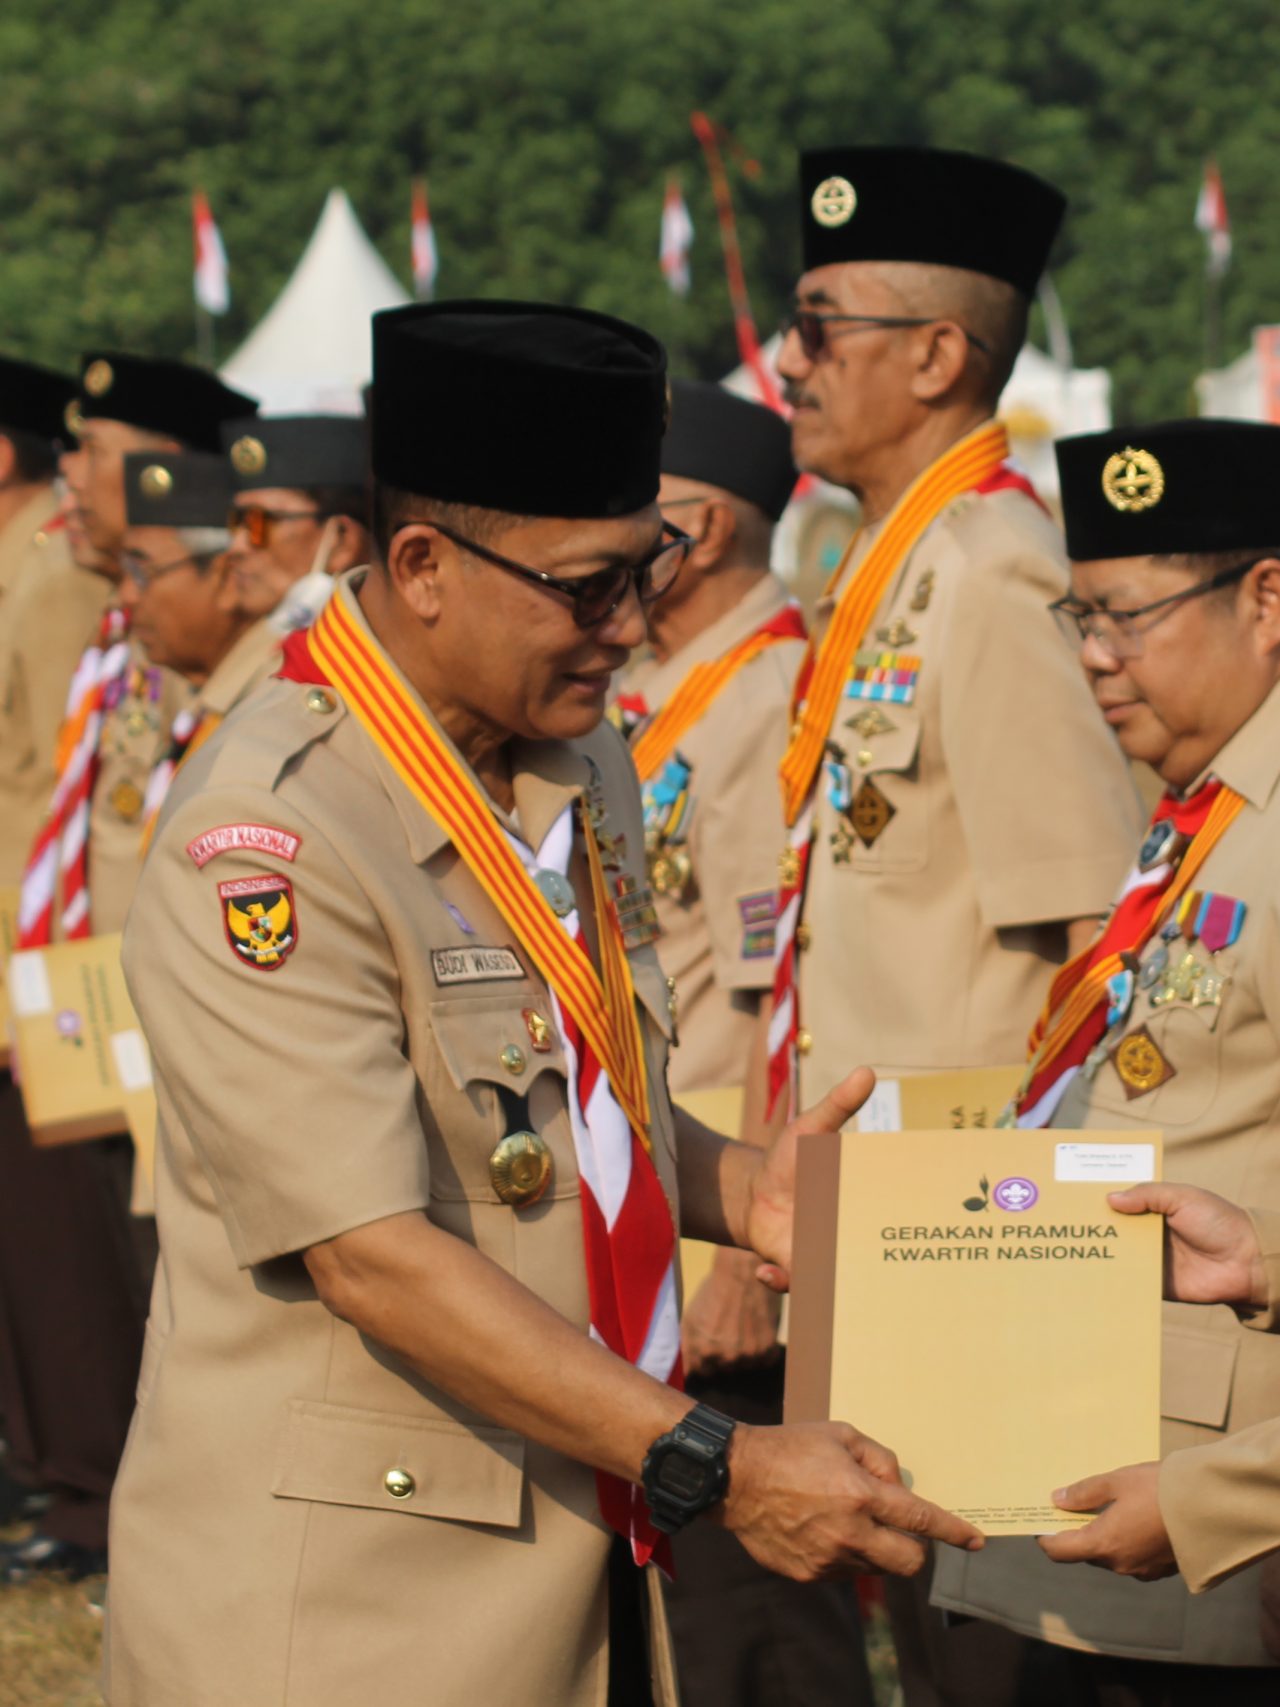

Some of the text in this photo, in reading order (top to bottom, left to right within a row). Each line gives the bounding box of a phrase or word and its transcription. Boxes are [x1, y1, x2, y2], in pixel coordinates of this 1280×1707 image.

[881, 1225, 1118, 1241] GERAKAN PRAMUKA
[883, 1245, 1115, 1261] KWARTIR NASIONAL
